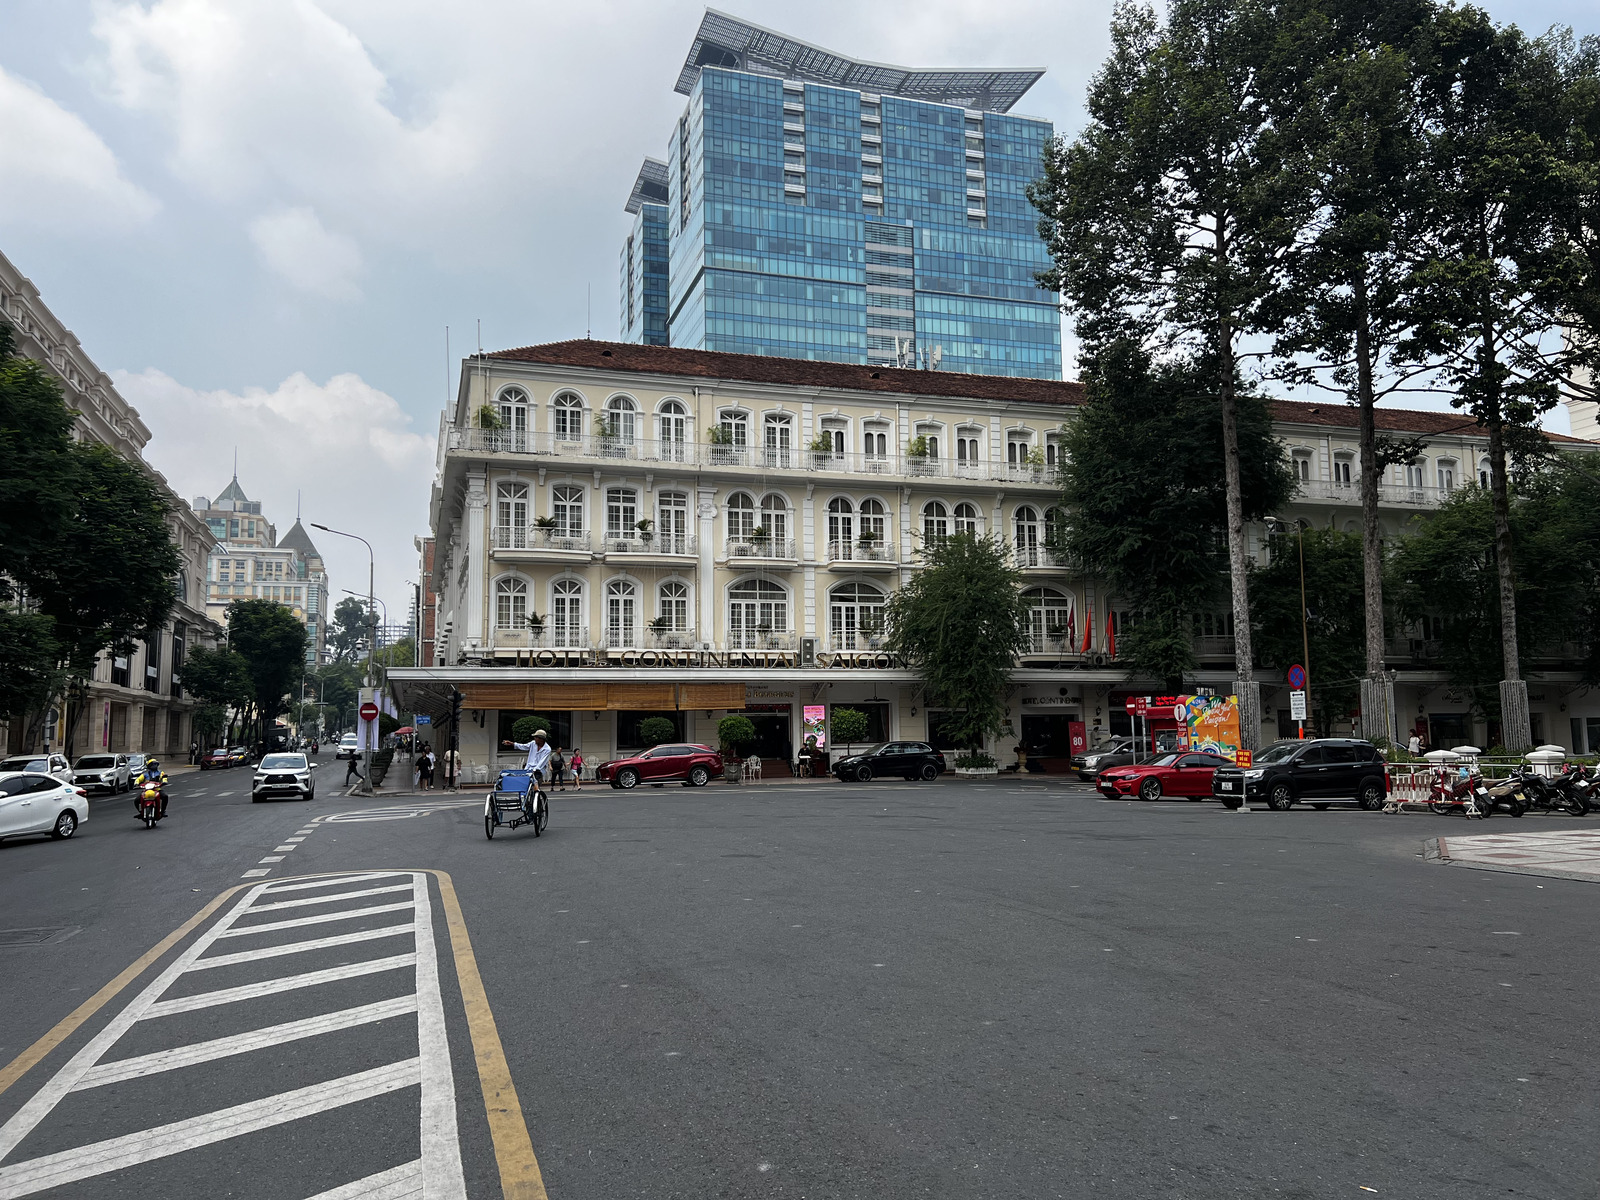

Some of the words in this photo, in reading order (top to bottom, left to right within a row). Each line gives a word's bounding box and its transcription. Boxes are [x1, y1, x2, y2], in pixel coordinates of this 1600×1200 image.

[516, 650, 602, 668] HOTEL
[620, 650, 802, 669] CONTINENTAL
[815, 652, 908, 670] SAIGON
[1211, 699, 1222, 709] We
[1204, 713, 1231, 728] Saigon!
